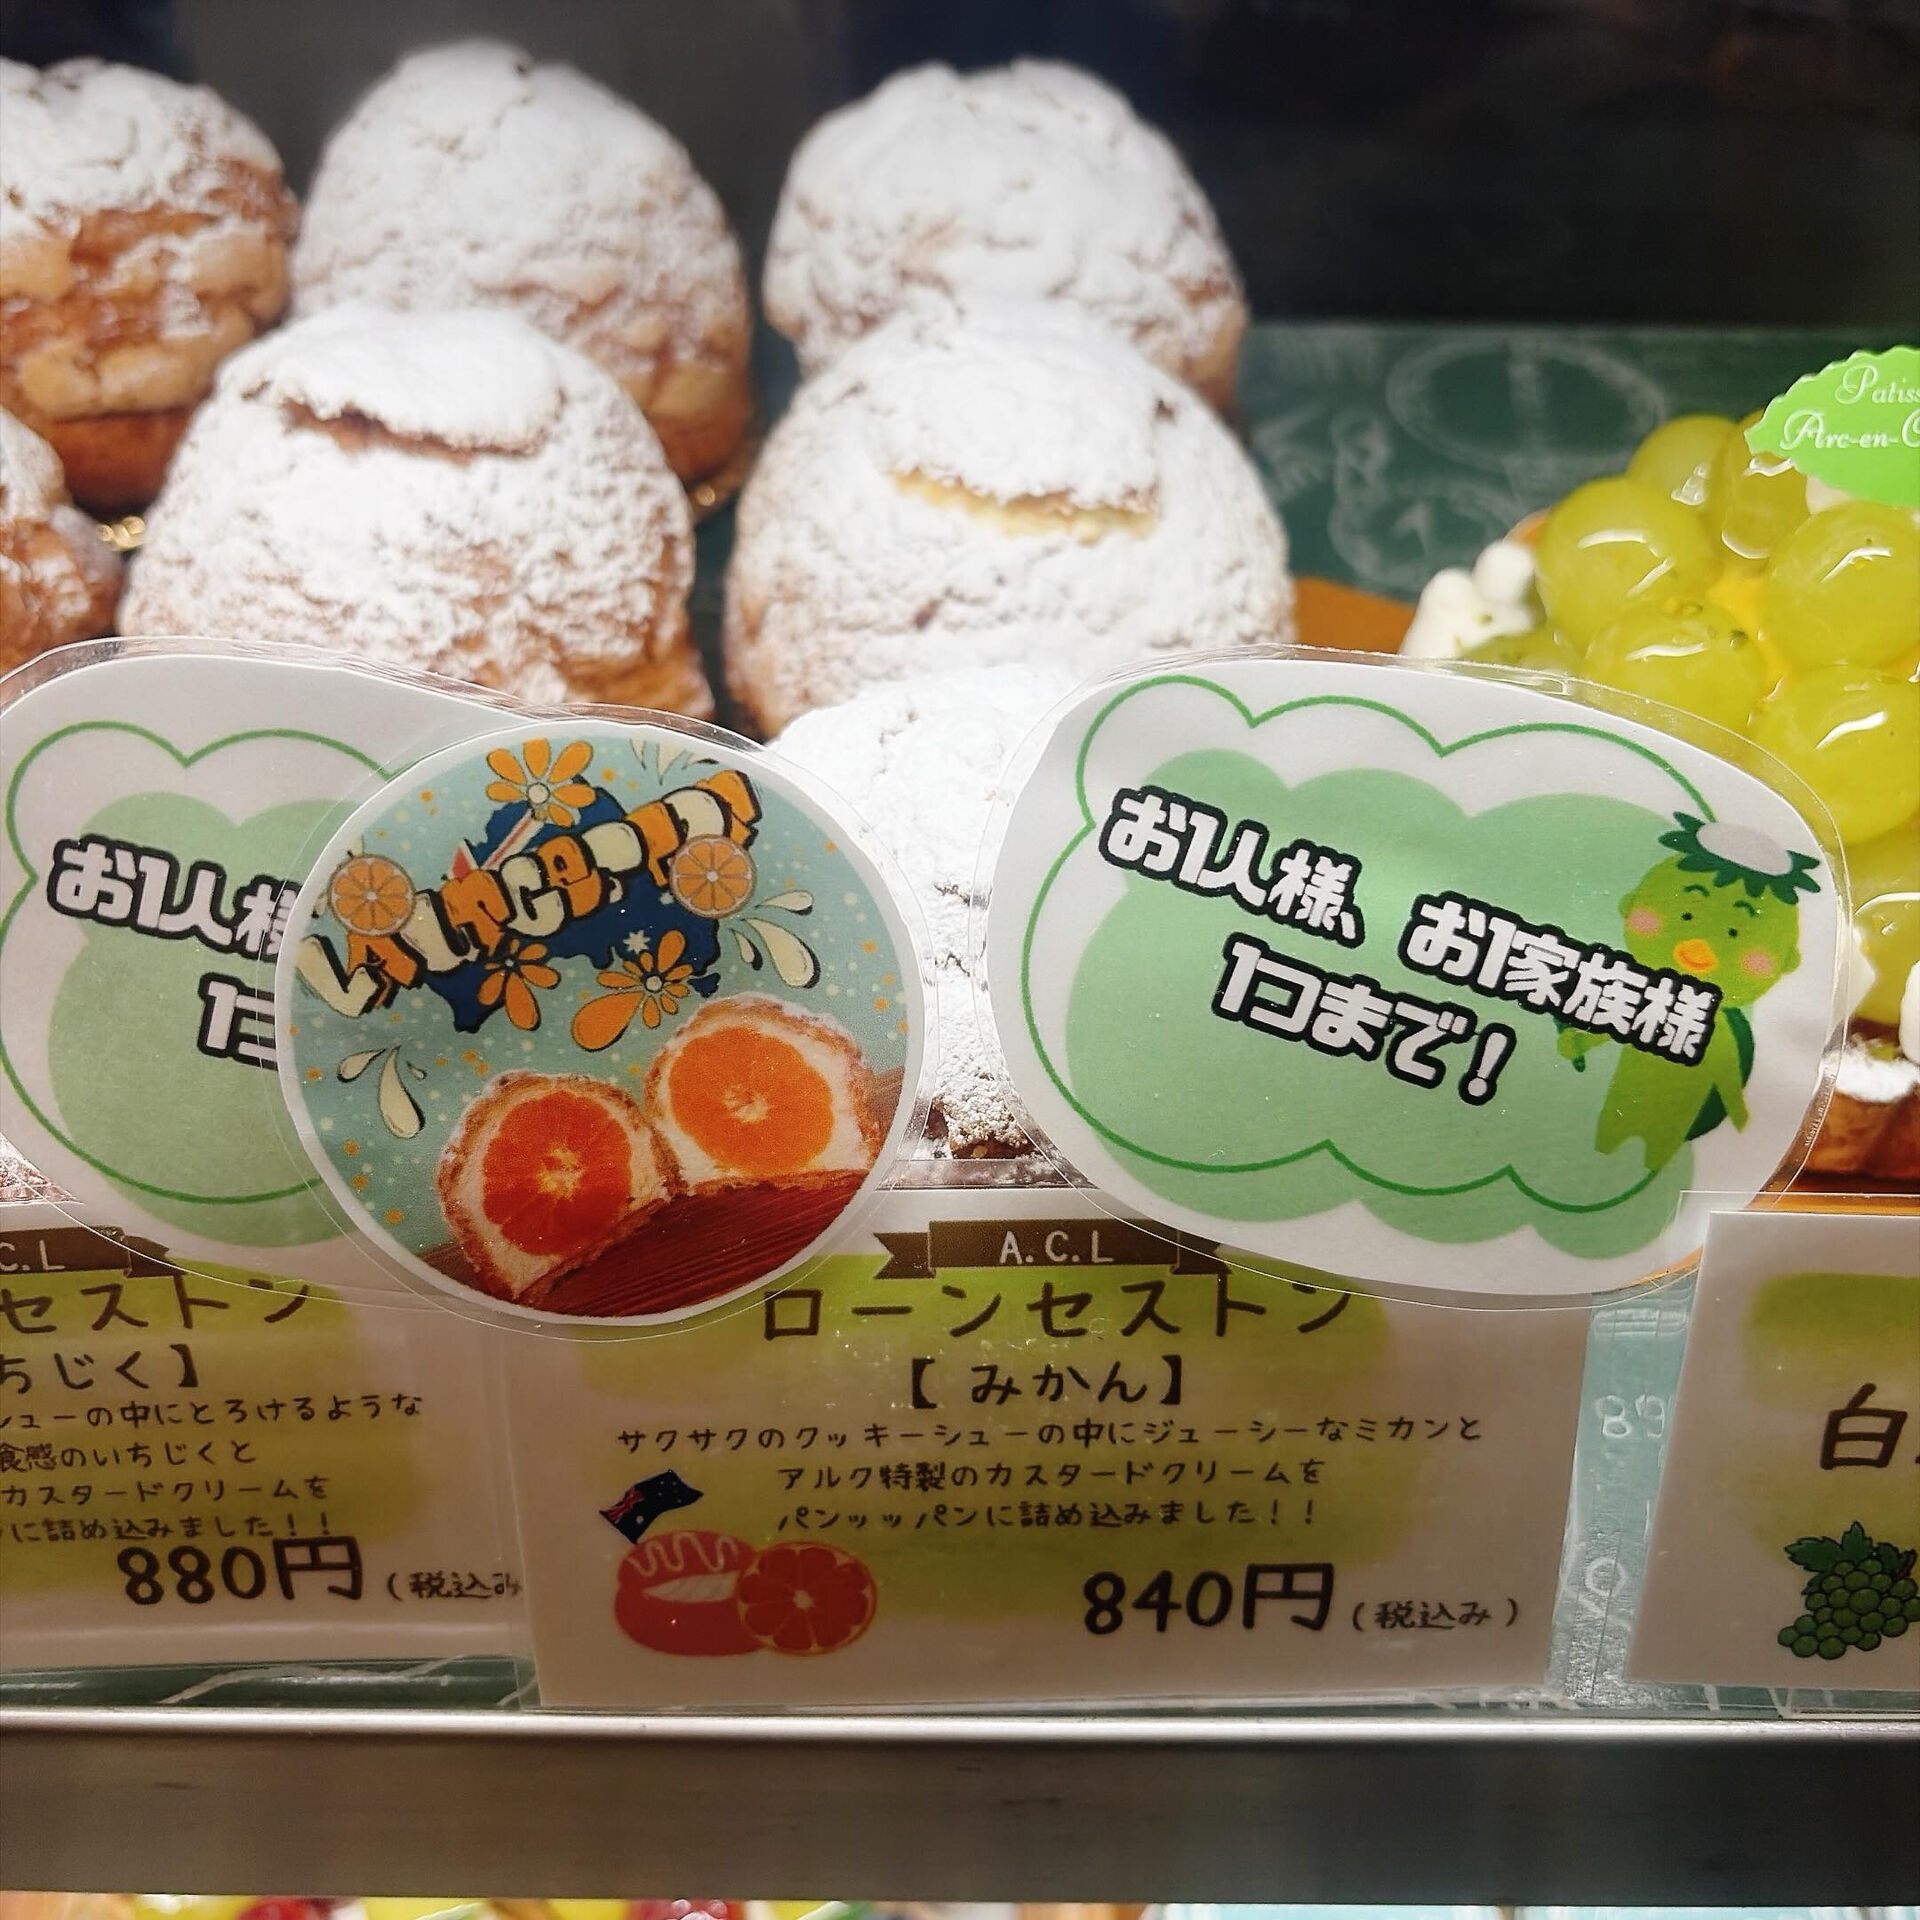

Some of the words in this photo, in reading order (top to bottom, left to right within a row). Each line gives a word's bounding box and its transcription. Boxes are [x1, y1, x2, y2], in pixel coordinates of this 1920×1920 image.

[1397, 891, 1723, 1066] お1家族様
[1000, 1230, 1114, 1265] A.C.L
[765, 1272, 1352, 1340] ローンセストン
[911, 1355, 1182, 1409] 【みかん】
[617, 1416, 1482, 1453] サクサクのクッキーシューの中にジューシーなミカンと
[1820, 1383, 1920, 1471] 白
[1, 1475, 330, 1506] カスタードクリームを
[777, 1458, 1326, 1492] アルク特製のカスタードクリームを
[0, 1511, 331, 1543] に詰め込みました！！
[117, 1535, 363, 1605] 880円
[1082, 1562, 1334, 1635] 840円
